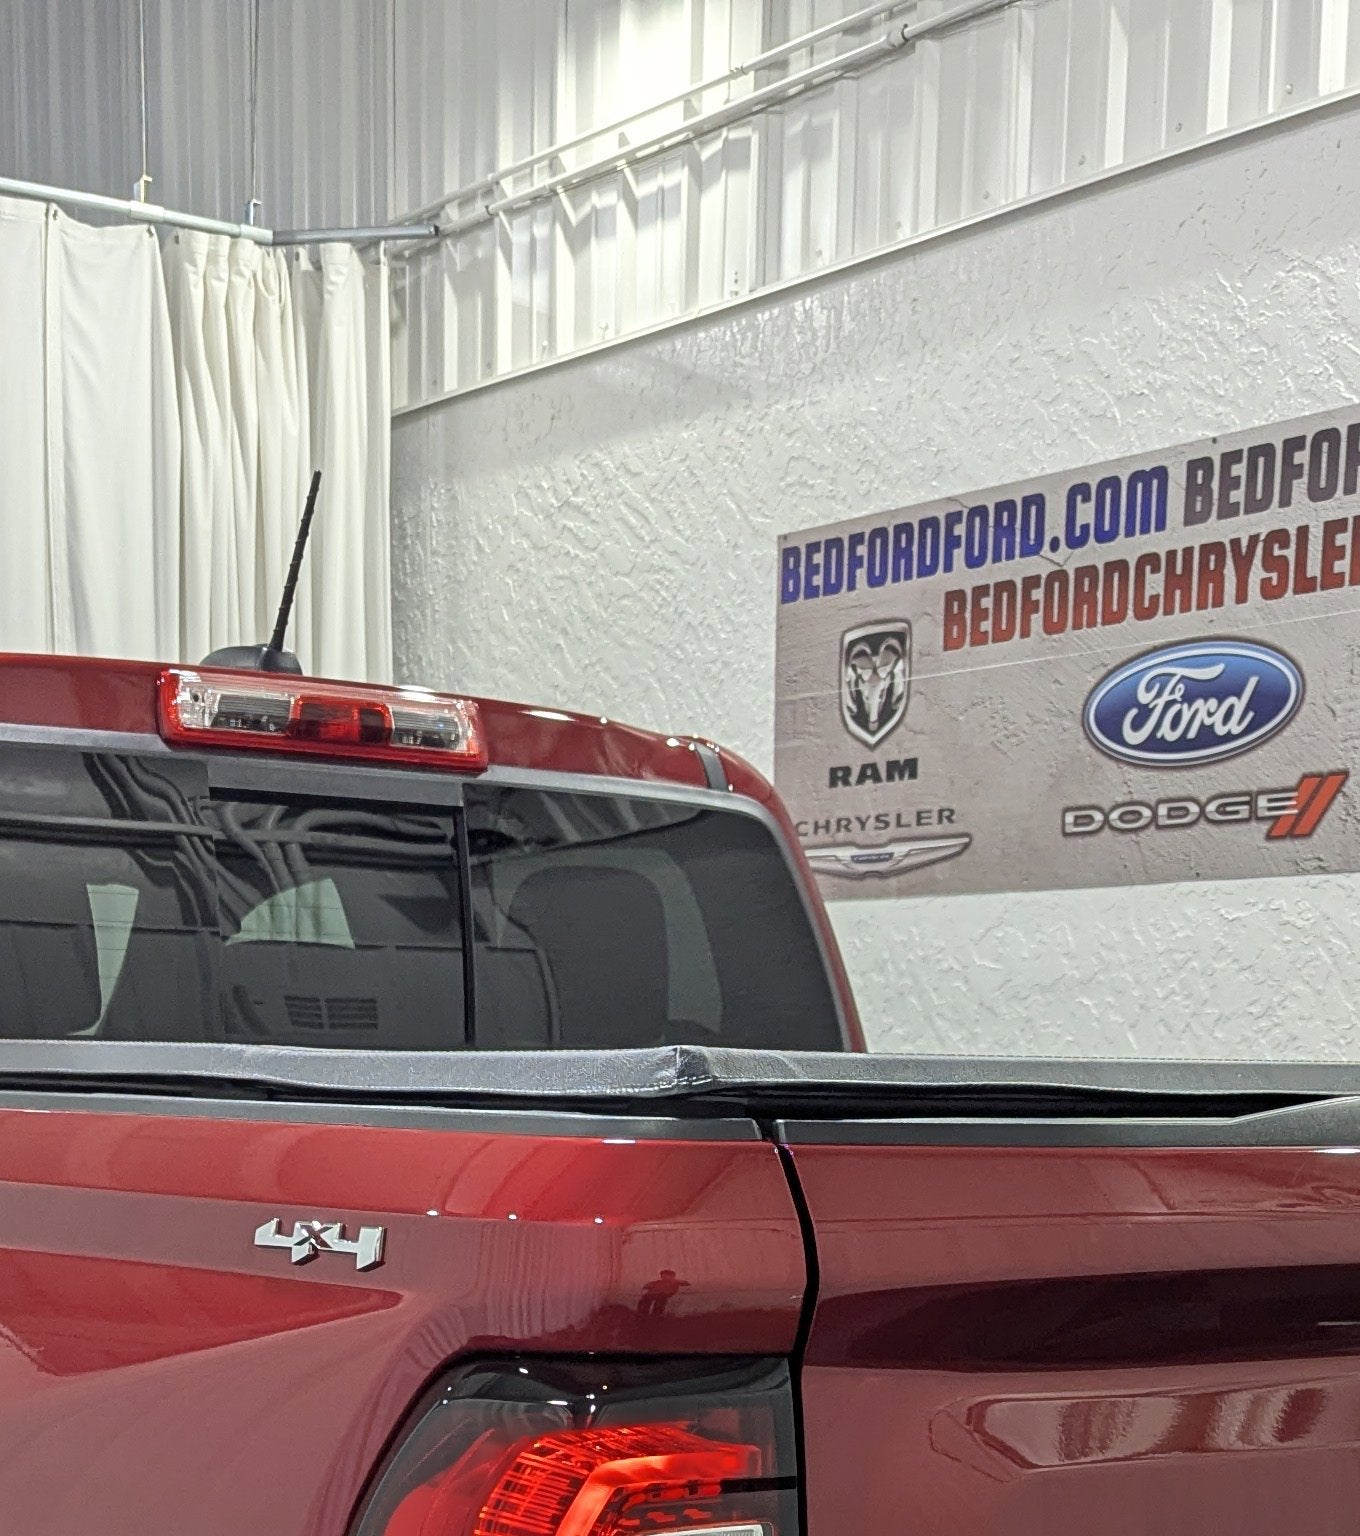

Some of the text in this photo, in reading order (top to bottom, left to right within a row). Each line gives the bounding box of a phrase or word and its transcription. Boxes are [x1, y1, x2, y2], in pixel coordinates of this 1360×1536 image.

[781, 464, 1168, 605] BEDFORDFORD.COM
[1122, 662, 1260, 746] Ford
[828, 757, 919, 789] RAM
[795, 808, 957, 837] CHRYSLER
[1062, 787, 1300, 837] DODGE
